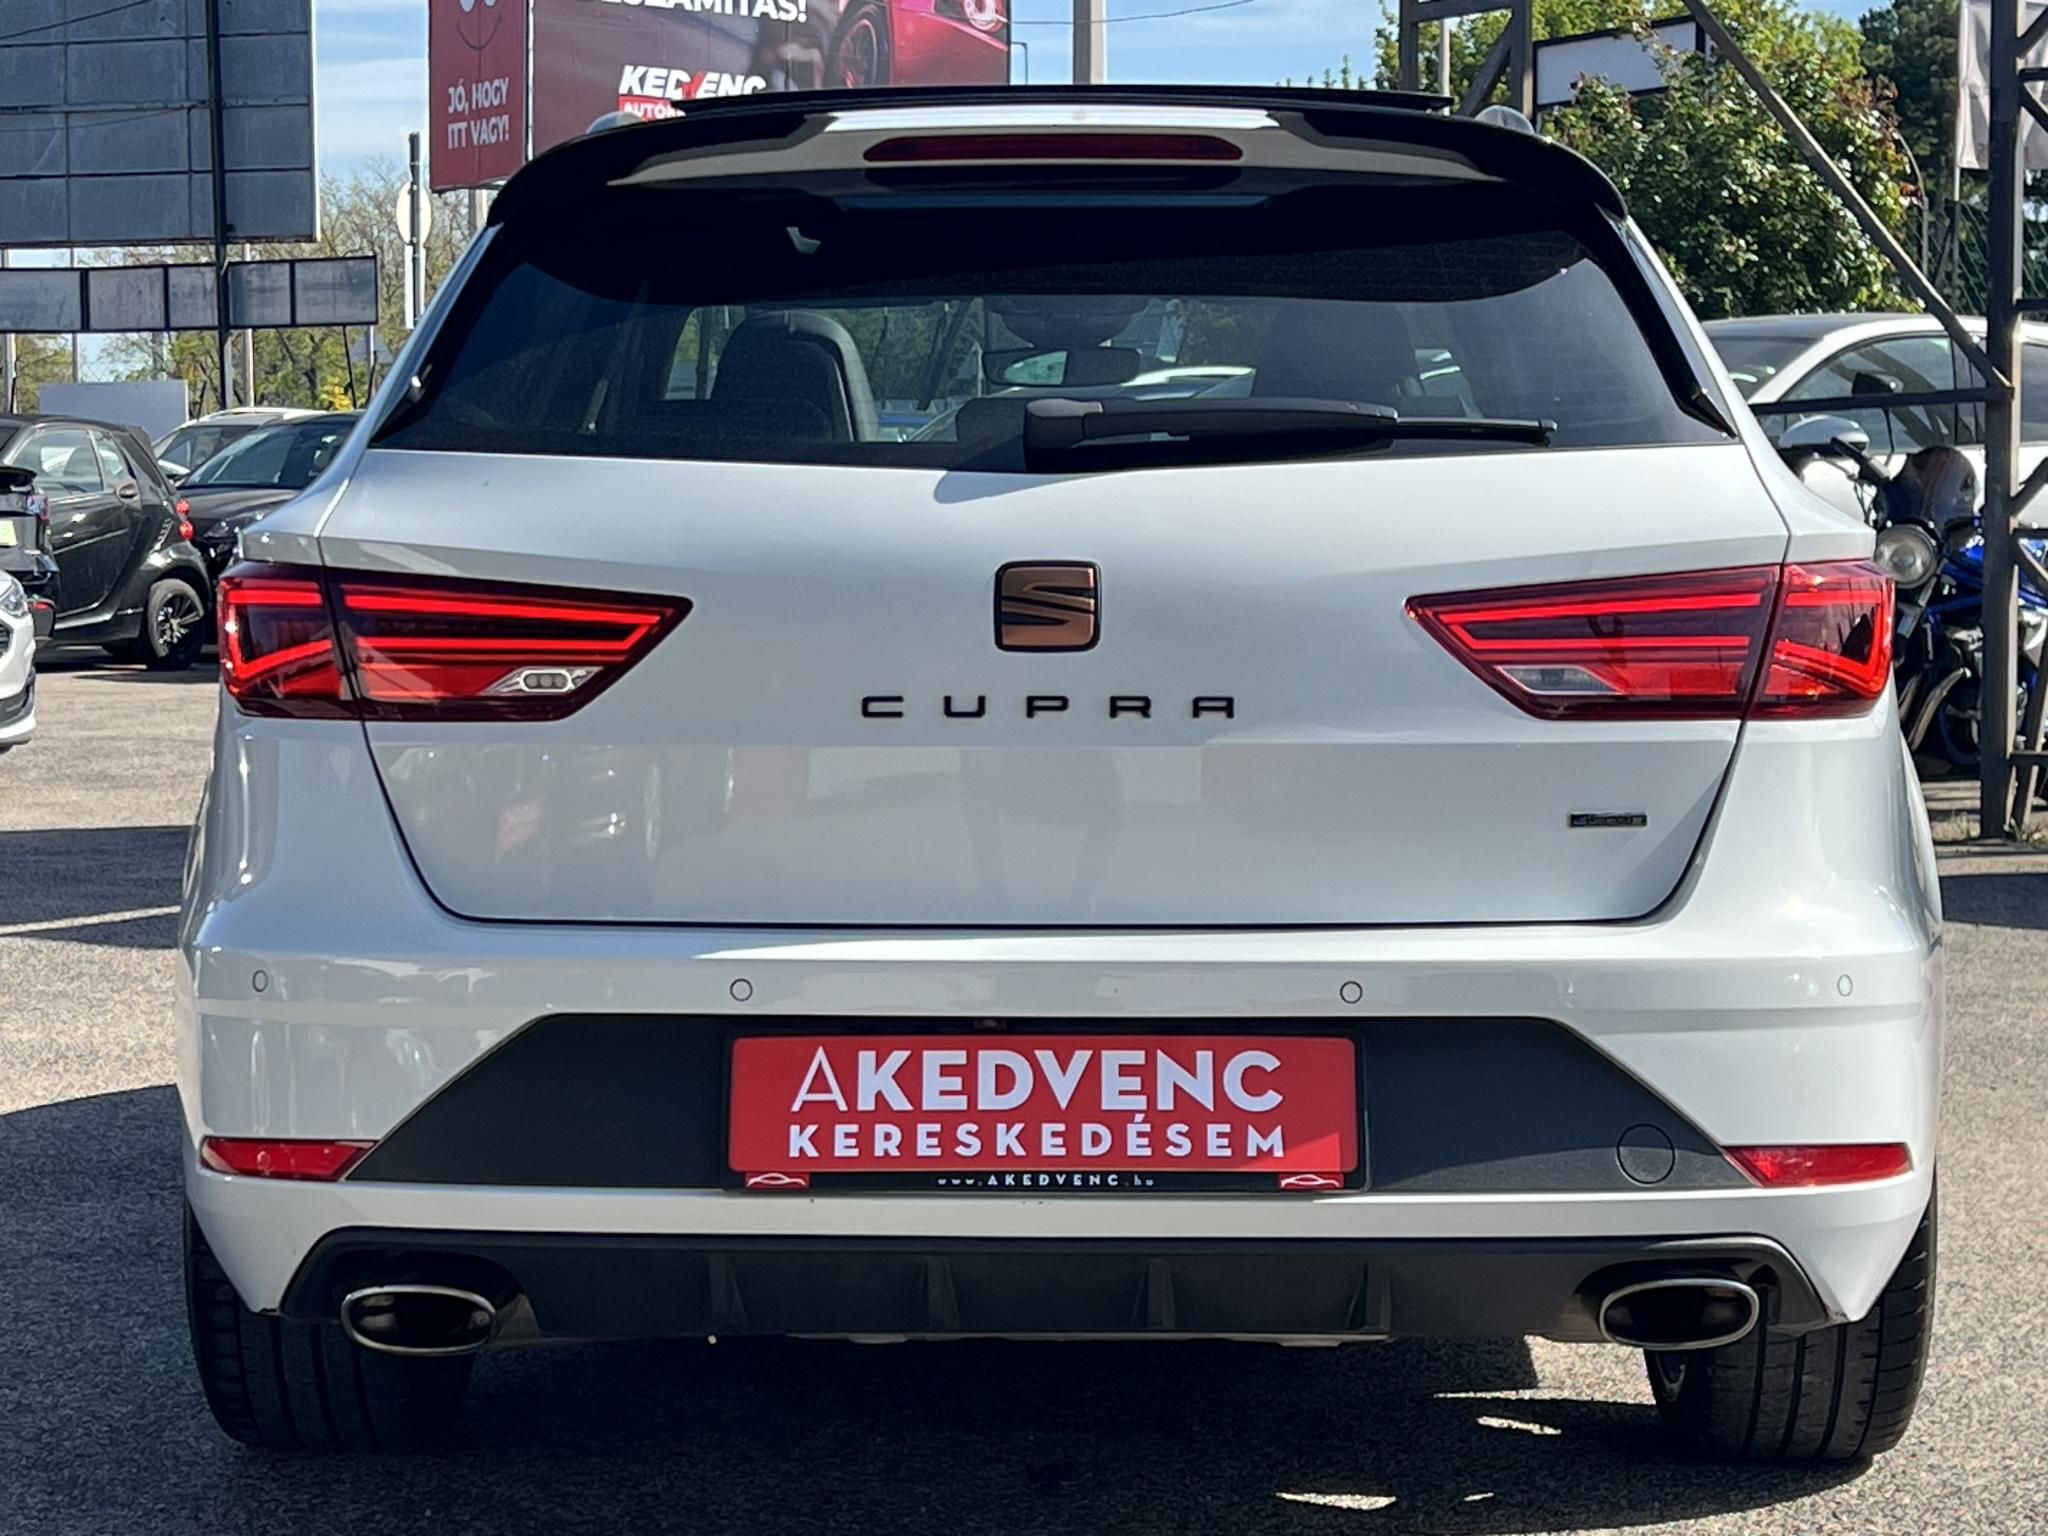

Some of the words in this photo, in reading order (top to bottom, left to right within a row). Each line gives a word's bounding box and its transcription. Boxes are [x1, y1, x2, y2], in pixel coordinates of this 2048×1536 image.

[447, 77, 469, 115] JÓ,
[471, 76, 510, 110] HOGY
[447, 121, 469, 150] ITT
[470, 114, 510, 147] VAGY!
[861, 695, 1235, 719] CUPRA
[788, 1113, 1285, 1158] KERESKEDÉSEM
